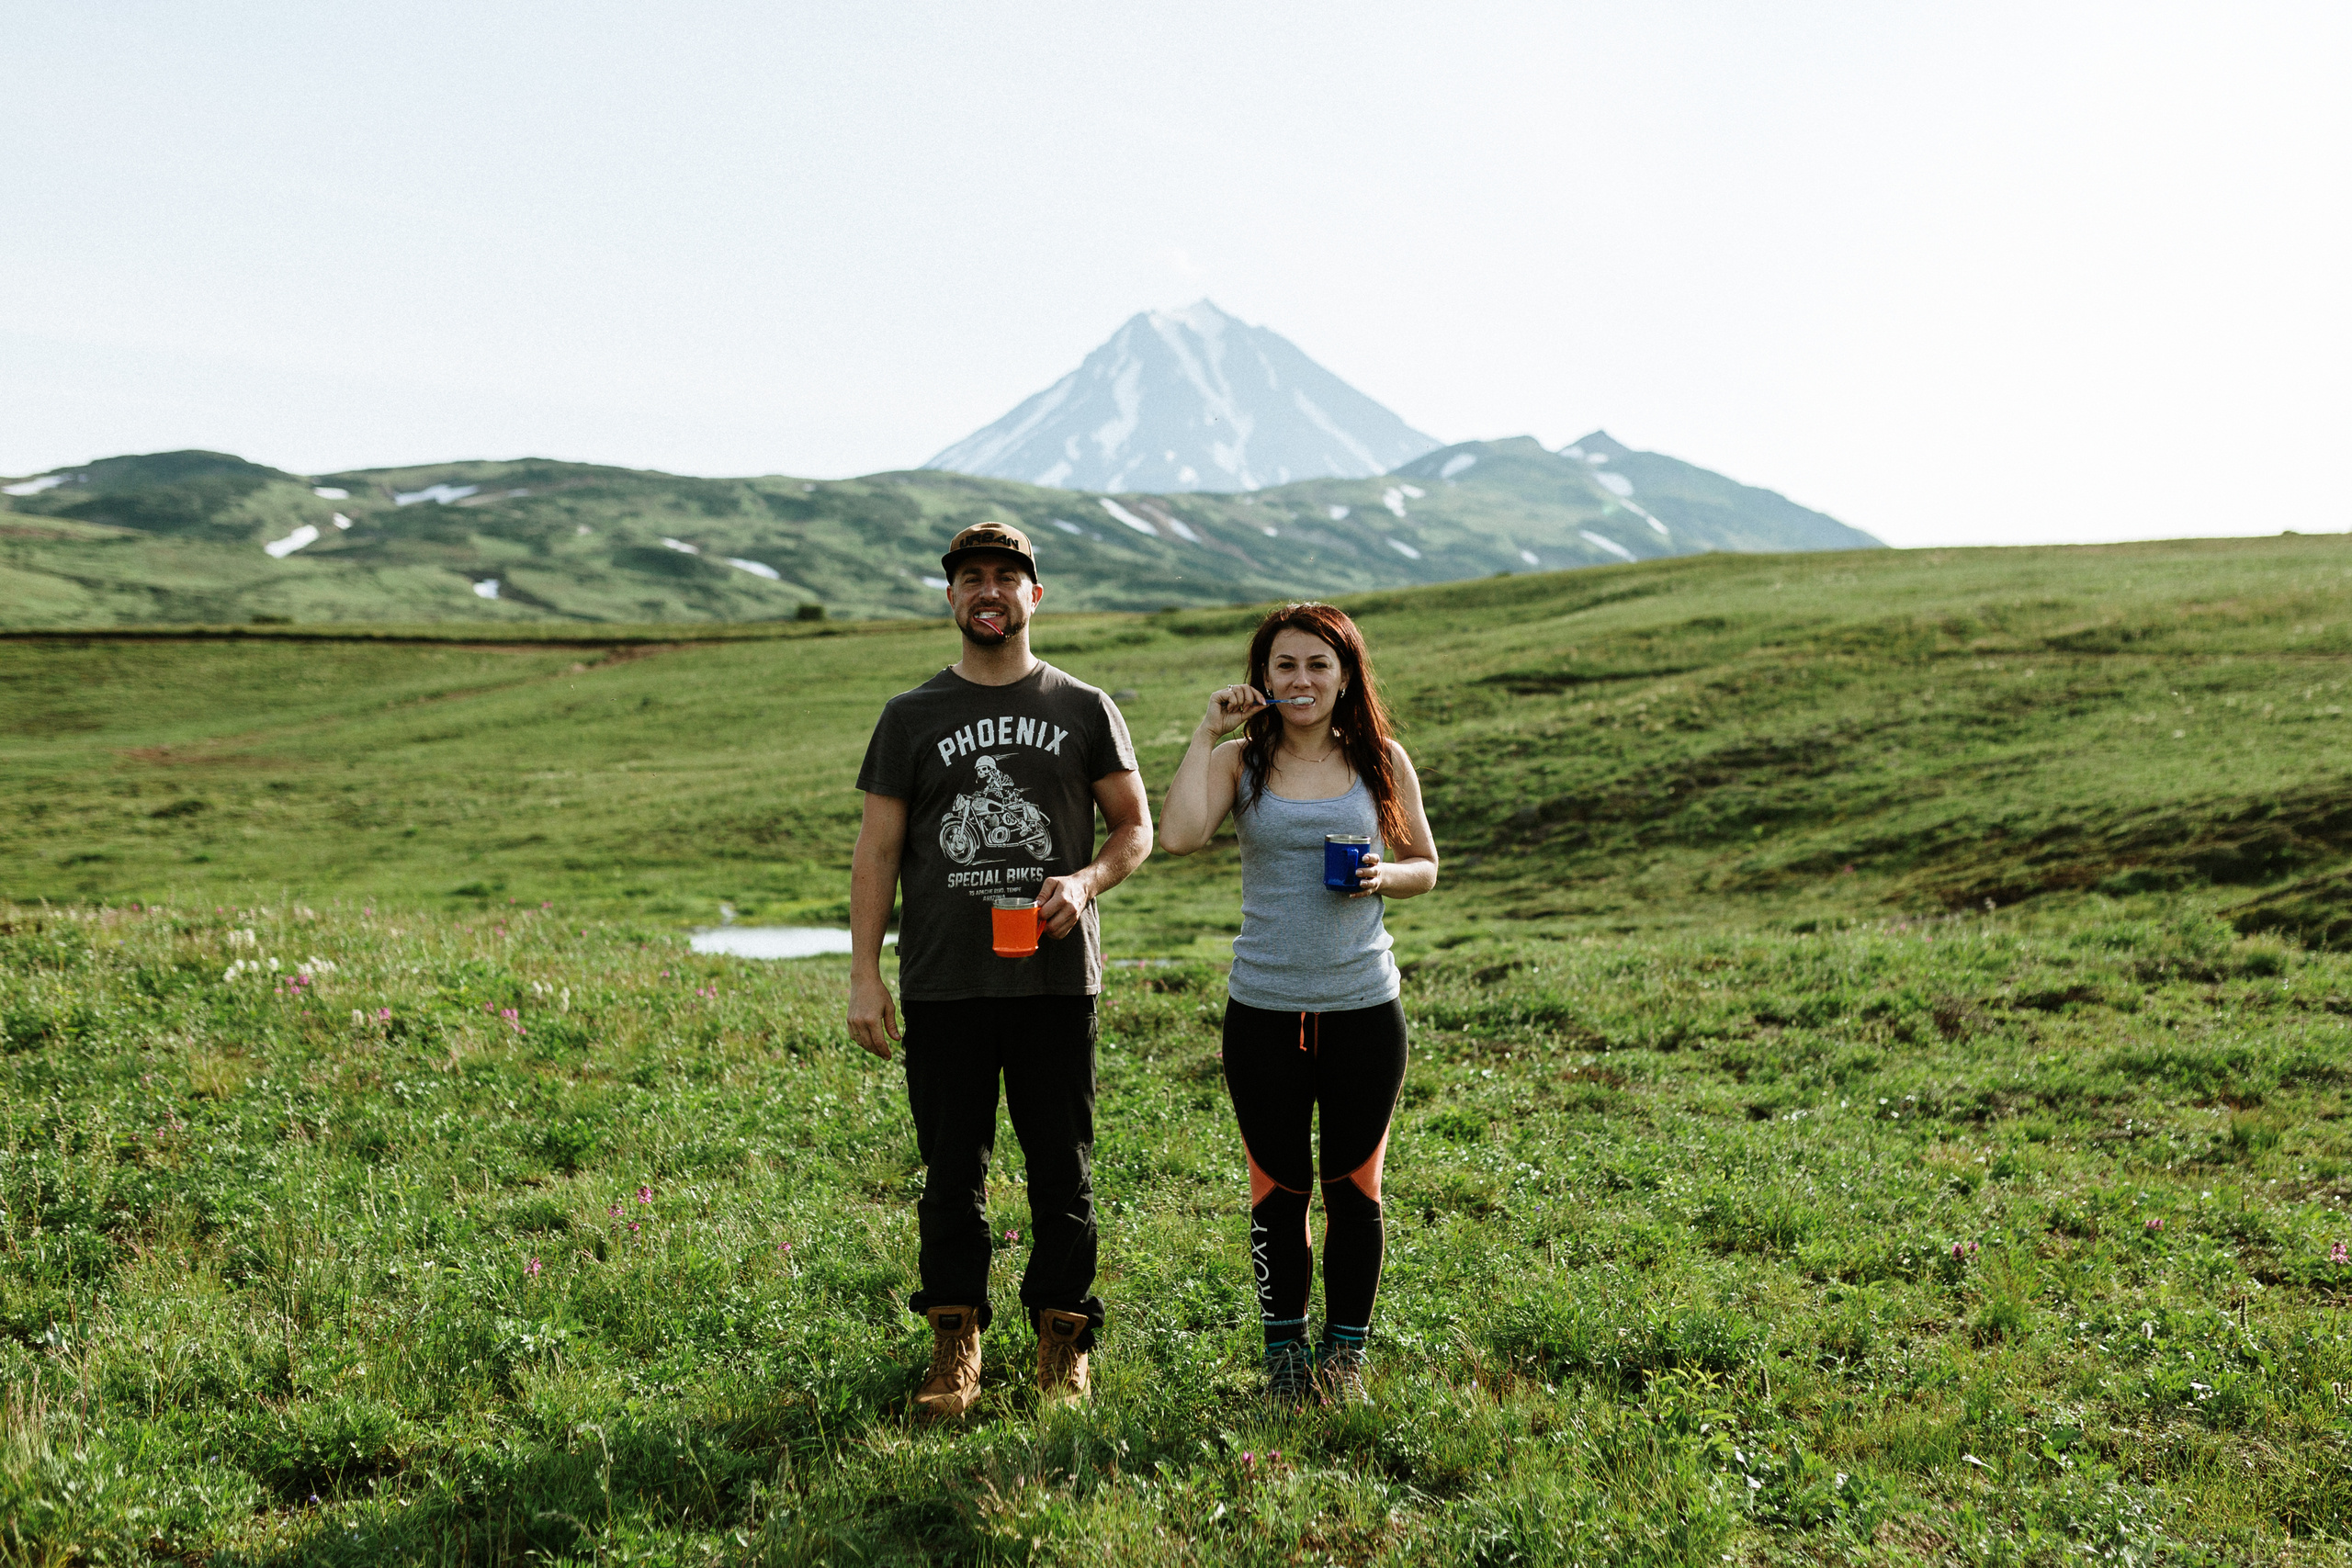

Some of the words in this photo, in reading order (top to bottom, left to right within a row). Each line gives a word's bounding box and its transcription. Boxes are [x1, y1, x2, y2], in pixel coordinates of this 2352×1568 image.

[959, 532, 1019, 550] URBAN
[937, 716, 1069, 767] PHOENIX
[947, 869, 1001, 888] SPECIAL
[1006, 867, 1044, 884] BIKES
